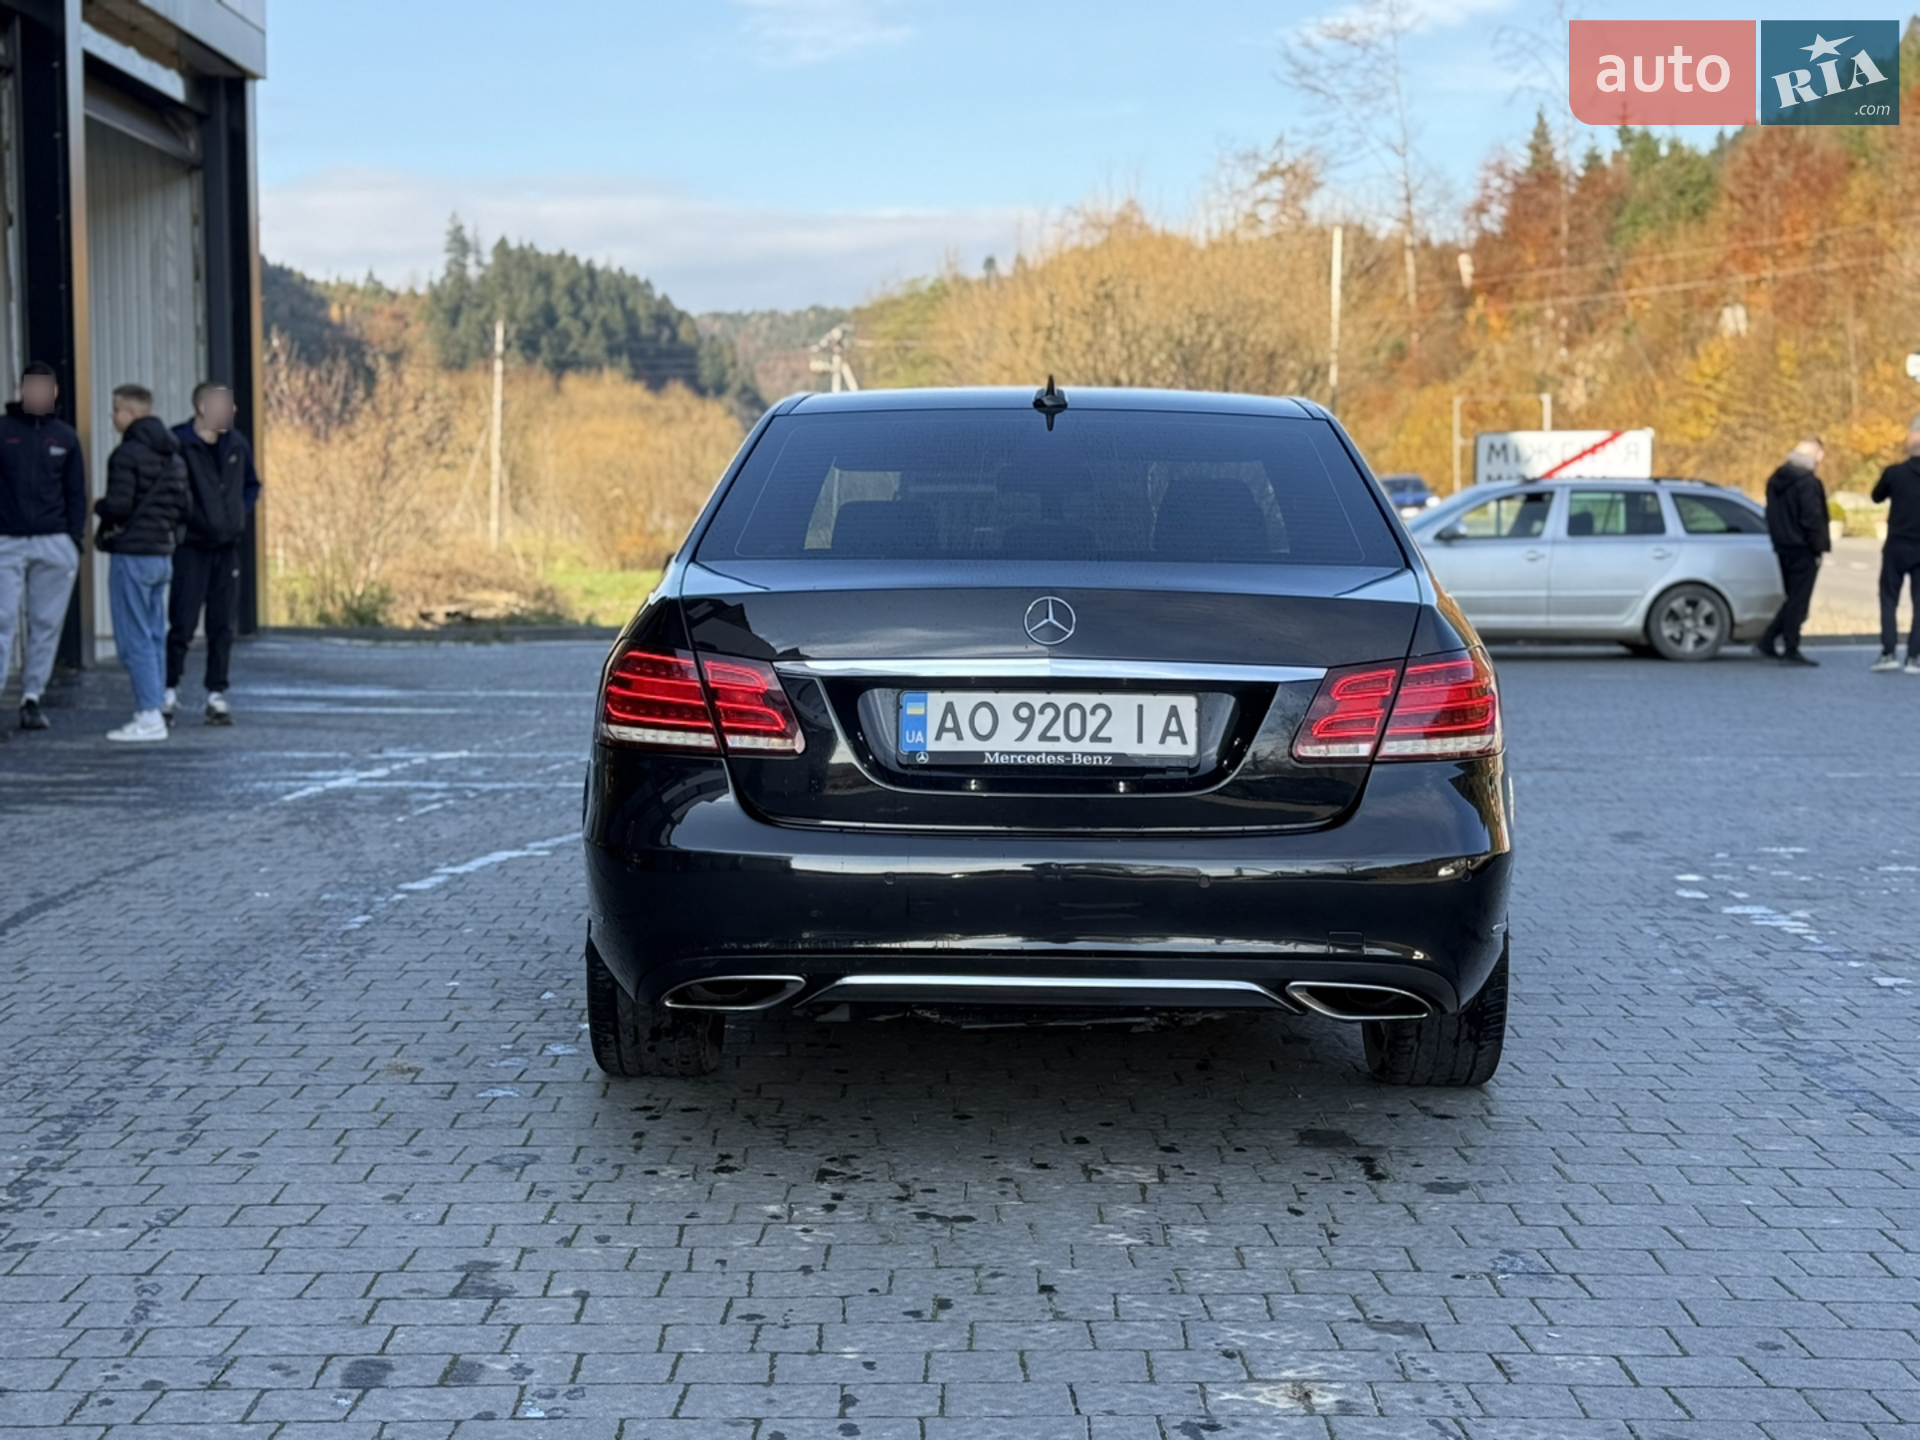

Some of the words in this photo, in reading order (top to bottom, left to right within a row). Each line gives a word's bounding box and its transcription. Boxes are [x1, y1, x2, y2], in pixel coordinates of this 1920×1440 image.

[934, 701, 999, 742] AO
[1012, 701, 1113, 743] 9202
[905, 731, 925, 744] UA
[983, 752, 1113, 766] Mercedes-Benz
